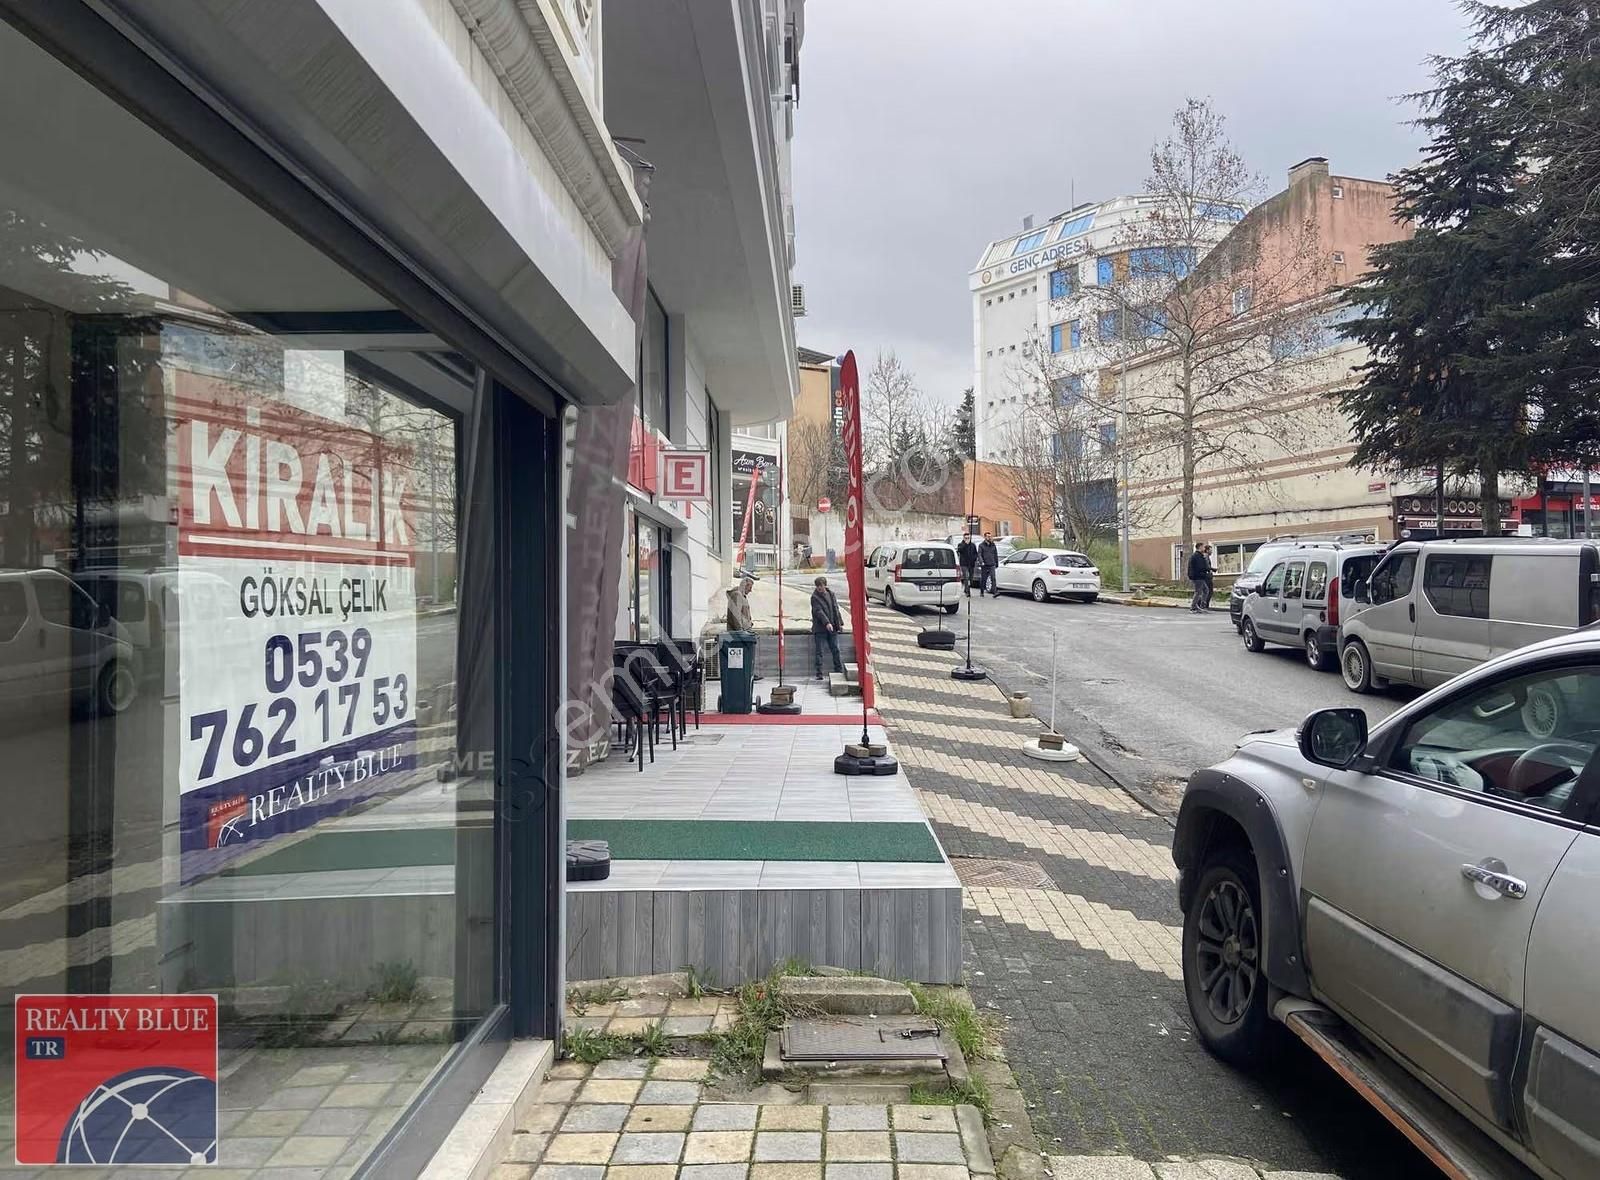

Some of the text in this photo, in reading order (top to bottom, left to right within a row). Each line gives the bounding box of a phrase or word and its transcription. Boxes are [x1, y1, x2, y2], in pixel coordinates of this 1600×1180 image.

[190, 406, 410, 546] KİRALIK
[674, 461, 695, 490] E
[239, 566, 388, 623] GÖKSAL ÇELİK
[264, 627, 373, 694] 0539
[189, 673, 409, 781] 762 17 53
[249, 743, 403, 828] REALTY BLUE
